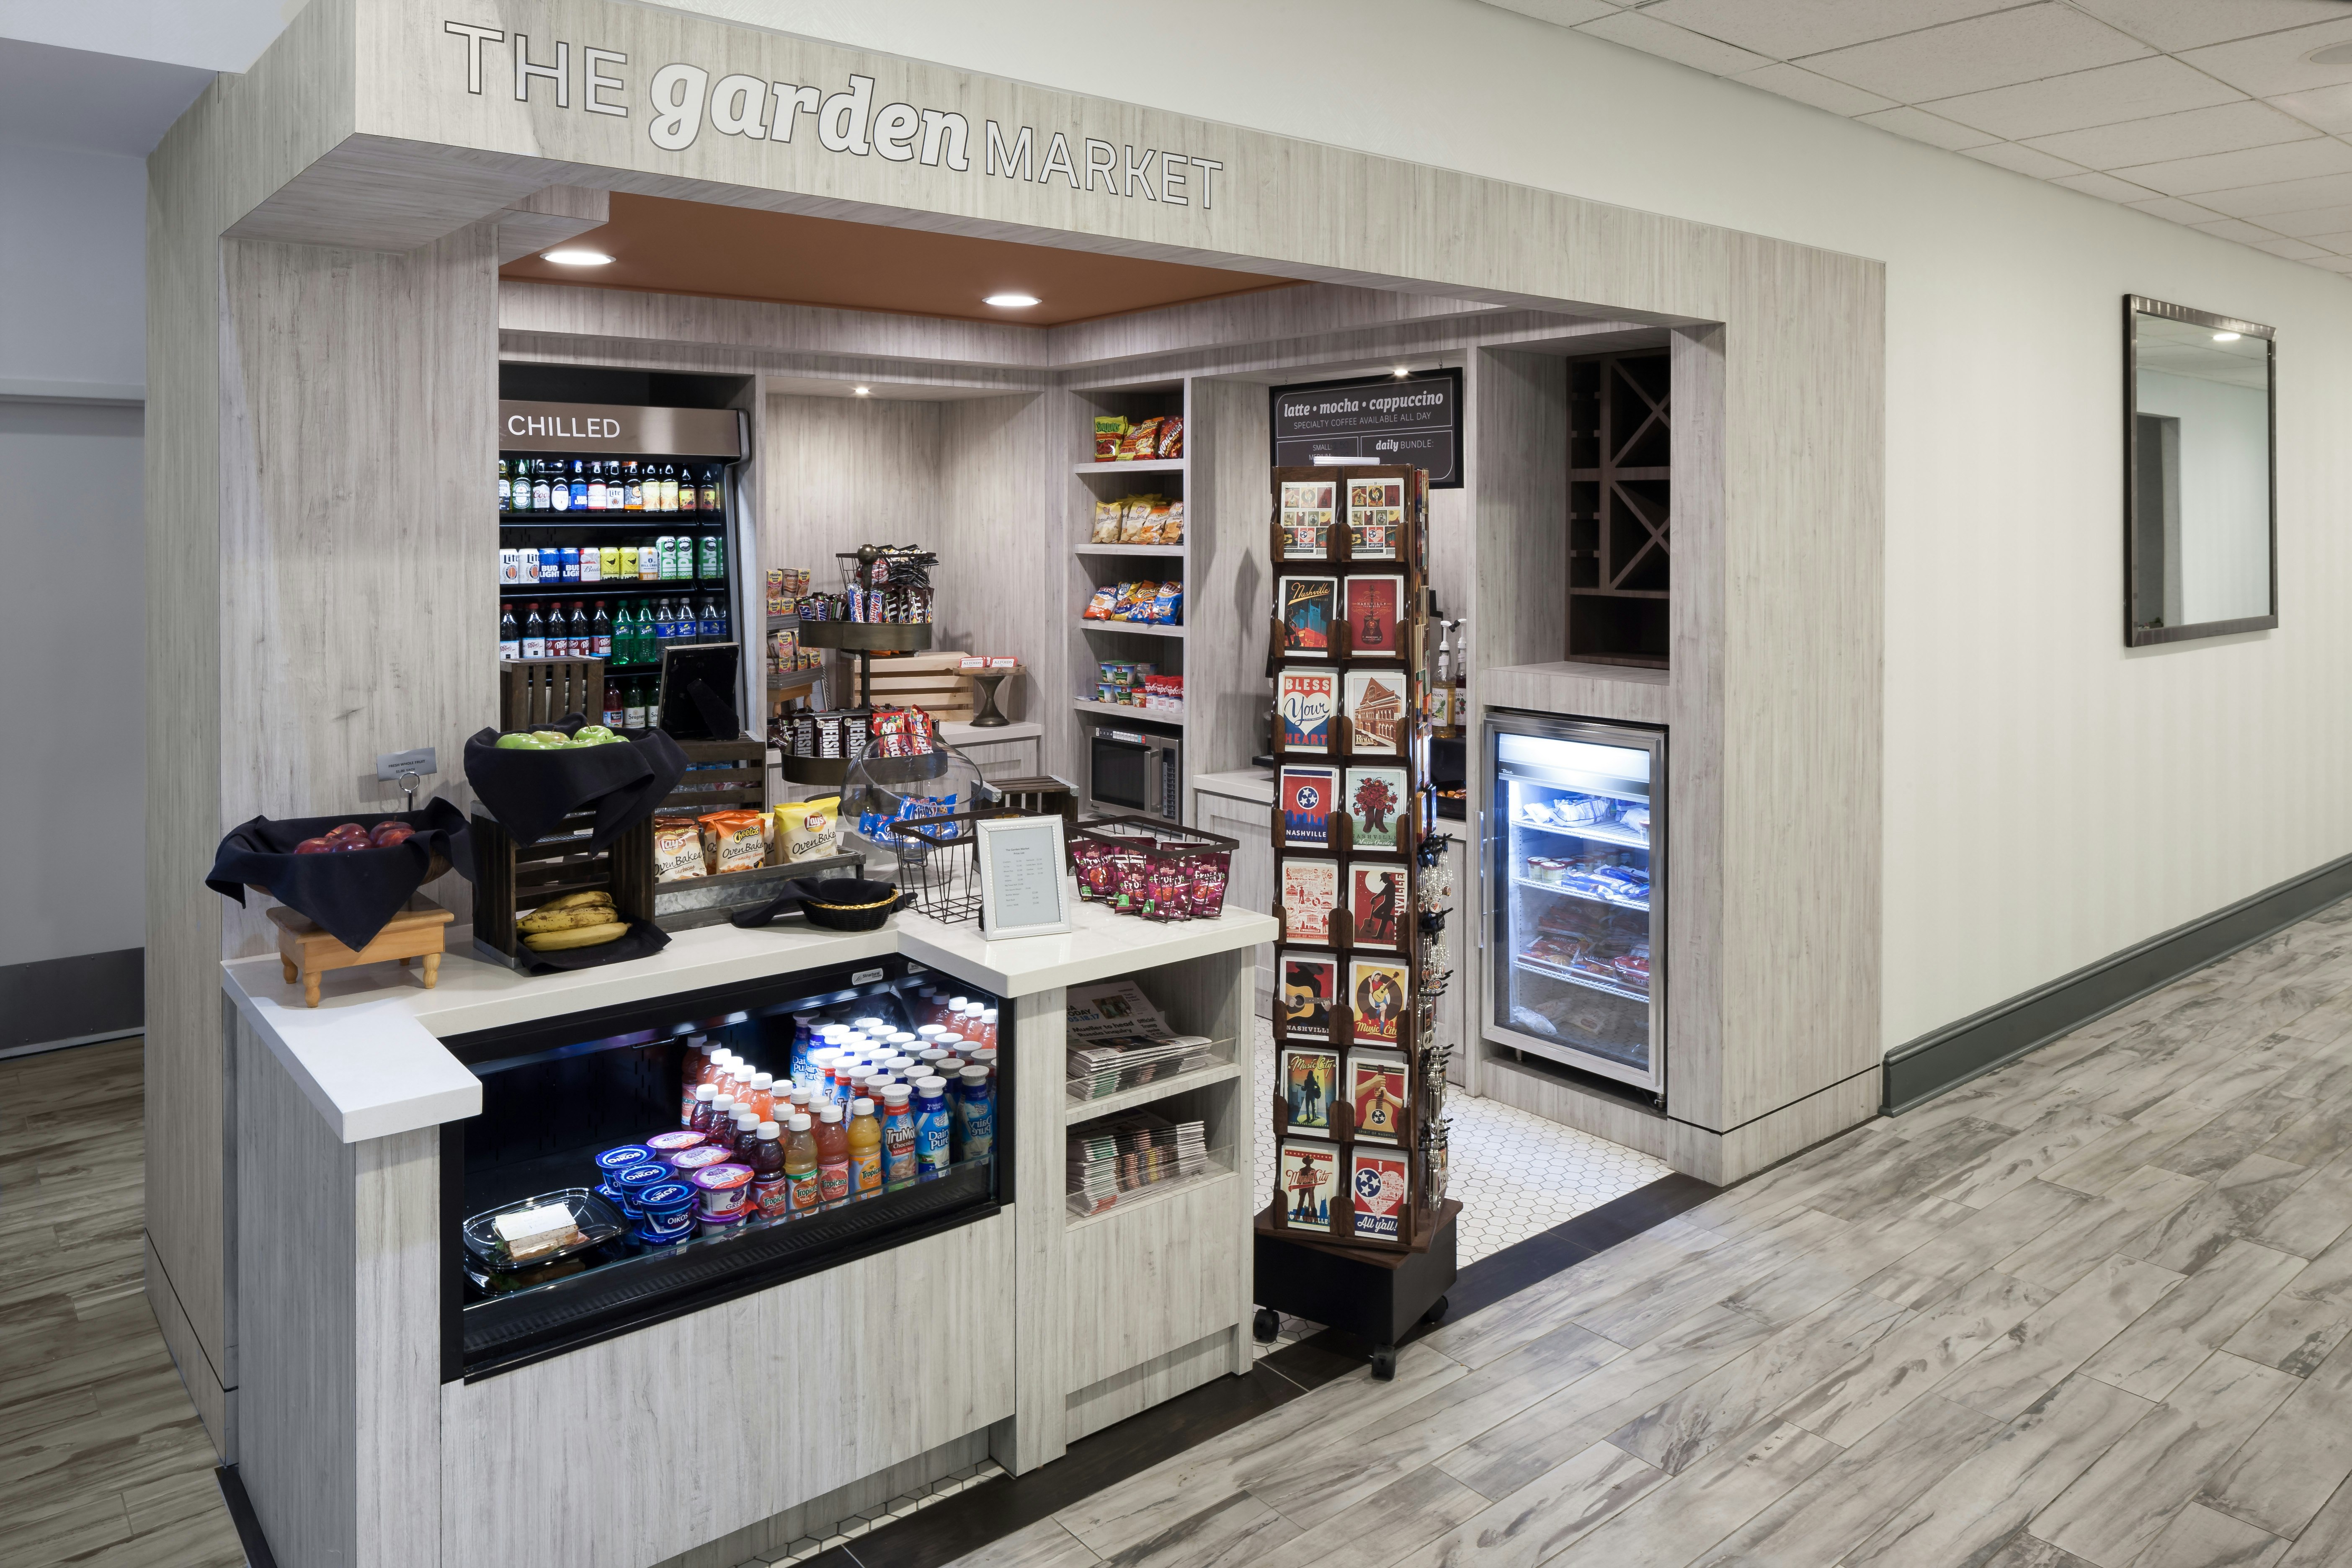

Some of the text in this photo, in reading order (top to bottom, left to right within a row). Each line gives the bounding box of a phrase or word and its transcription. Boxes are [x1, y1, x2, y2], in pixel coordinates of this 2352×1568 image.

[444, 20, 1223, 211] THE garden MARKET
[1284, 391, 1443, 417] latte mocha cappuccino
[508, 415, 621, 438] CHILLED
[1294, 420, 1328, 429] SPECIALTY
[1331, 418, 1357, 426] COFFEE
[1359, 415, 1398, 424] AVAILABLE
[1417, 412, 1431, 420] DAY
[1376, 439, 1434, 452] daily BUNDLE:
[663, 551, 676, 572] IPA
[678, 549, 692, 572] IPA
[1291, 583, 1330, 599] Nashville
[1285, 678, 1330, 691] BLESS
[1284, 696, 1330, 727] Your
[1285, 733, 1327, 745] HEART
[1356, 734, 1374, 743] RYMAN
[807, 815, 824, 828] Lay's
[733, 826, 760, 844] Cheetos
[792, 828, 836, 854] Oven Bake
[662, 839, 683, 851] Lay's
[722, 839, 763, 859] Oven Bake
[676, 848, 702, 865] Baked
[733, 853, 752, 861] Crunchy
[675, 865, 695, 874] Barbecue
[1124, 881, 1142, 889] frui
[1066, 1008, 1091, 1017] ODAY
[1068, 1014, 1099, 1022] 05.18.17
[1287, 1025, 1329, 1034] NASHVILL
[1356, 1021, 1380, 1033] Music
[792, 1055, 805, 1064] Dai
[793, 1064, 805, 1073] Pu
[1291, 1056, 1335, 1078] Music City
[893, 1139, 914, 1149] Chocolate
[931, 1137, 949, 1150] Pure
[607, 1152, 640, 1163] OIKOS
[1378, 1161, 1383, 1172] I
[626, 1169, 658, 1181] OIKOS
[708, 1171, 735, 1180] GREEK
[862, 1167, 882, 1179] Tropica
[1285, 1169, 1332, 1185] Music City
[821, 1179, 847, 1188] Tropicana
[650, 1186, 677, 1202] OIKOS
[726, 1199, 745, 1210] GREEK
[763, 1194, 786, 1207] Tropican
[668, 1213, 688, 1225] OIKOS
[1295, 1215, 1328, 1224] NASHVILLE
[1357, 1216, 1397, 1232] All y'all!
